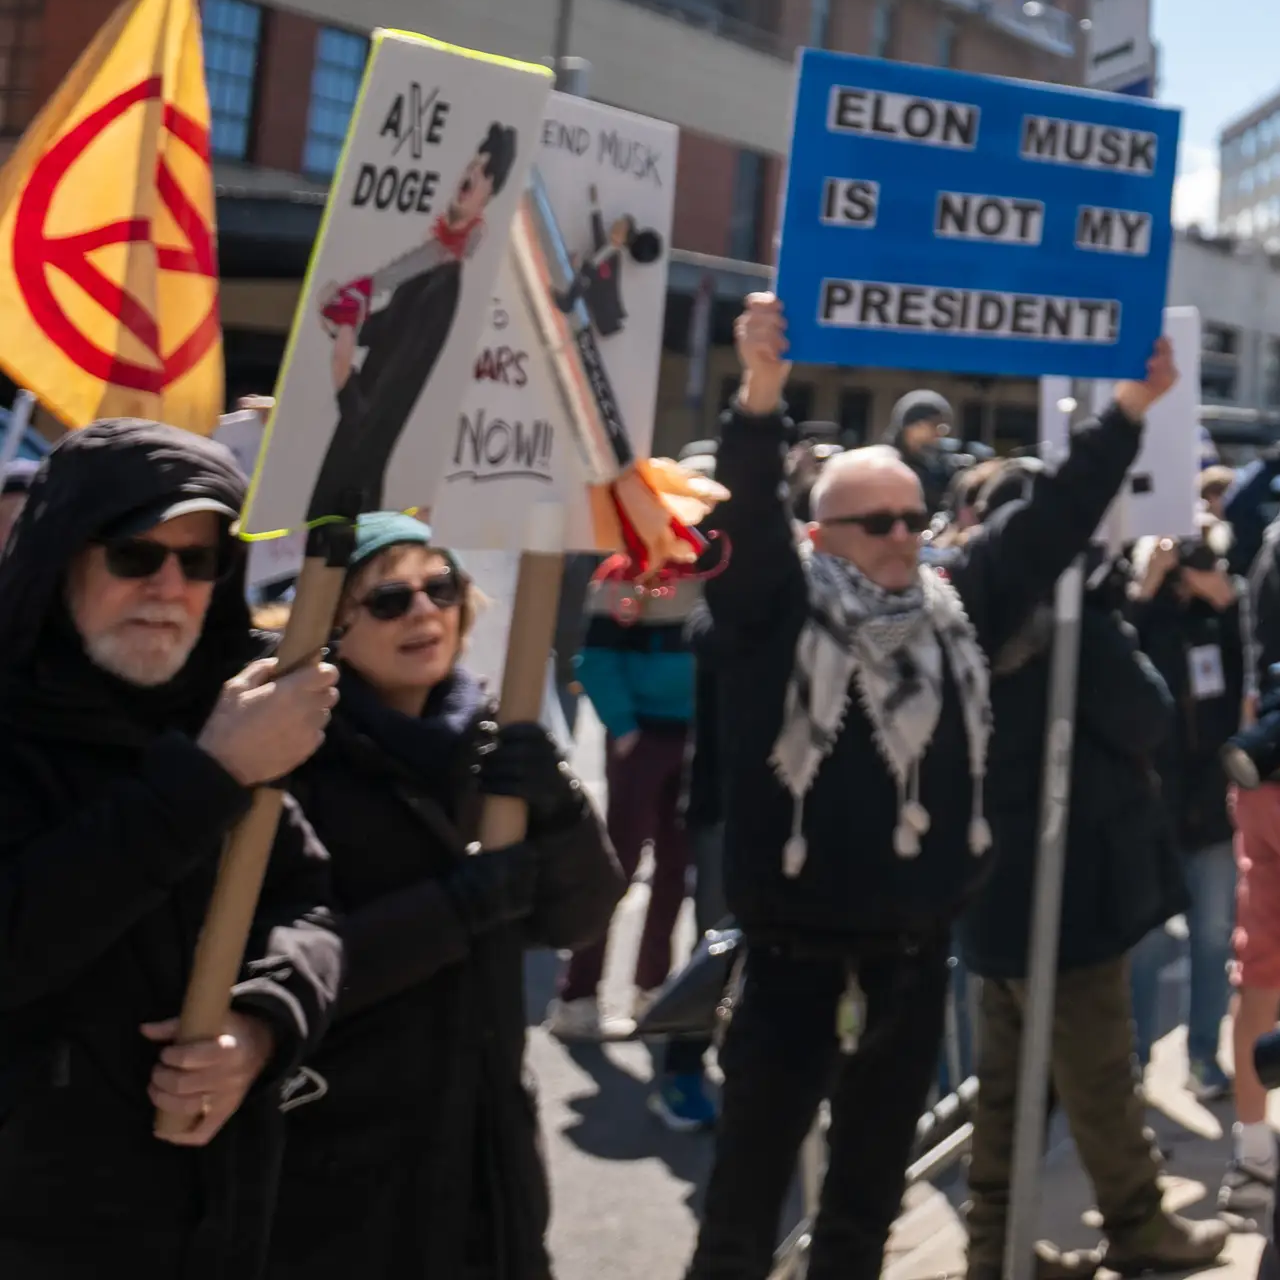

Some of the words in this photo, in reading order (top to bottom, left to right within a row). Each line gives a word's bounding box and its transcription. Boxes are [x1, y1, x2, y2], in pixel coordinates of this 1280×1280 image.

[540, 118, 591, 157] END
[597, 126, 663, 187] MUSK
[834, 91, 977, 146] ELON
[1022, 117, 1154, 171] MUSK
[352, 163, 440, 213] DOGE
[824, 178, 876, 222] IS
[936, 195, 1041, 241] NOT
[1077, 208, 1149, 252] MY
[823, 281, 1118, 341] PRESIDENT!
[473, 345, 528, 388] ARS
